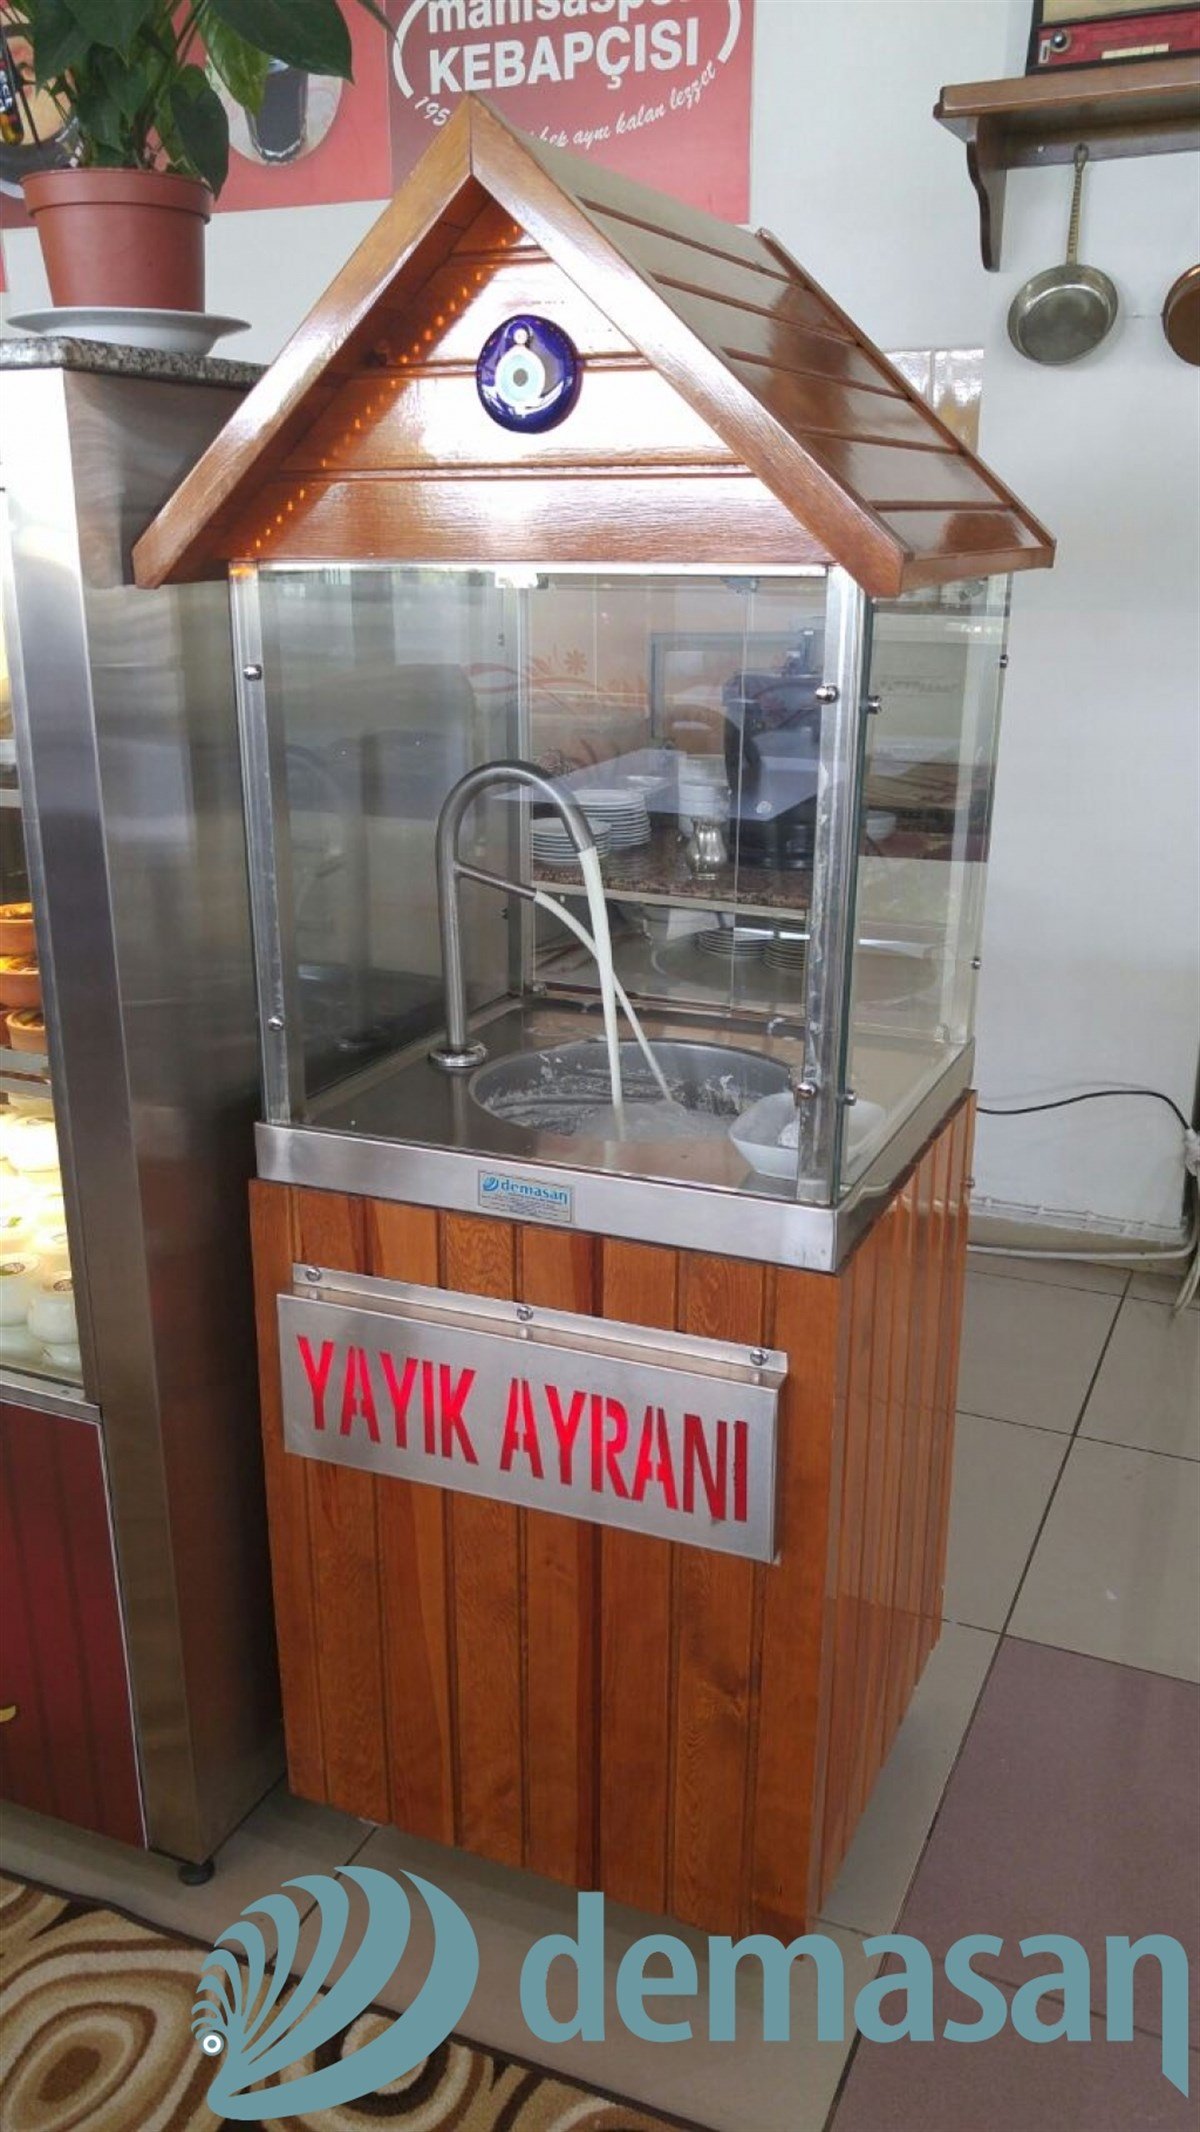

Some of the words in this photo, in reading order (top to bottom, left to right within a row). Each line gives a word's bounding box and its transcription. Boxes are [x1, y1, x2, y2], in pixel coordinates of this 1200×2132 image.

[428, 0, 690, 33] manisasp
[429, 17, 700, 94] KEBAPÇISI
[415, 96, 451, 126] 195
[616, 104, 666, 134] kalan
[669, 60, 716, 110] lezzet
[501, 1179, 568, 1205] demasan
[297, 1335, 479, 1466] YAYIK
[499, 1378, 748, 1523] AYRANI
